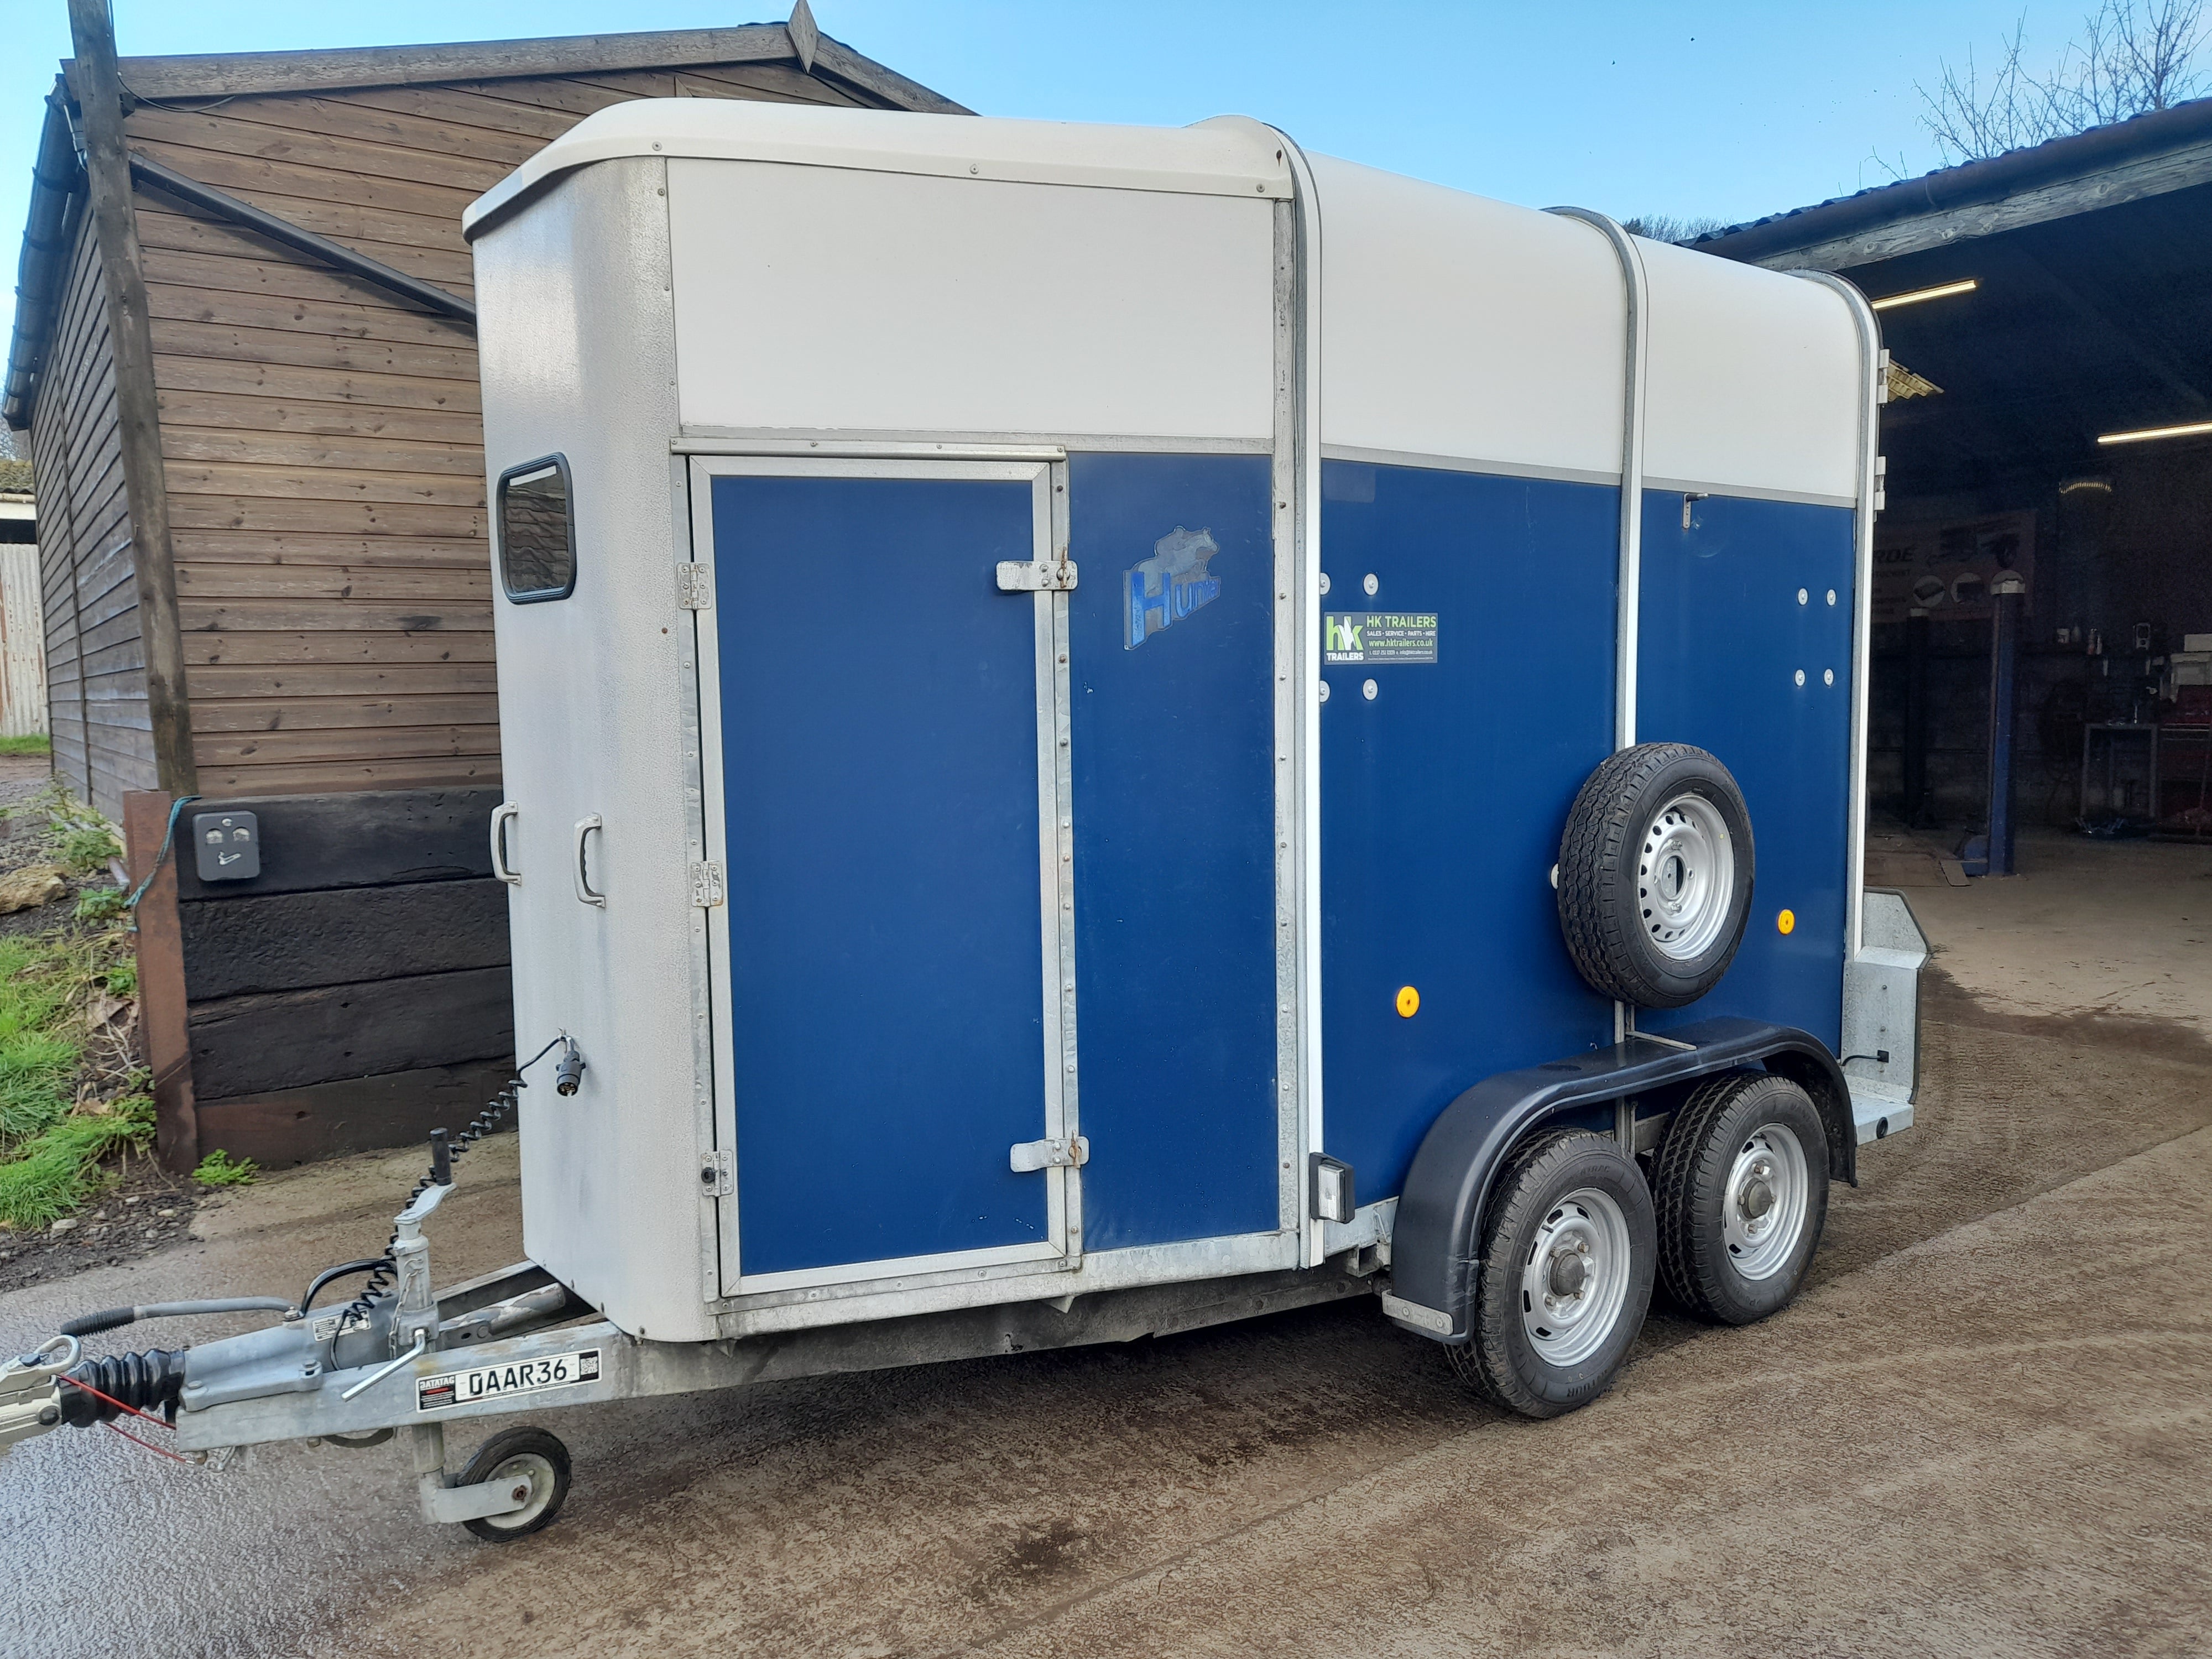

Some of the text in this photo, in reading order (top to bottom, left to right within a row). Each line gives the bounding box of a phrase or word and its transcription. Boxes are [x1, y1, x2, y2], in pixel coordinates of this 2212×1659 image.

[1366, 615, 1437, 628] HK TRAILERS
[1369, 638, 1433, 648] www.hktrailers.co.uk
[1327, 652, 1364, 661] TRAILERS
